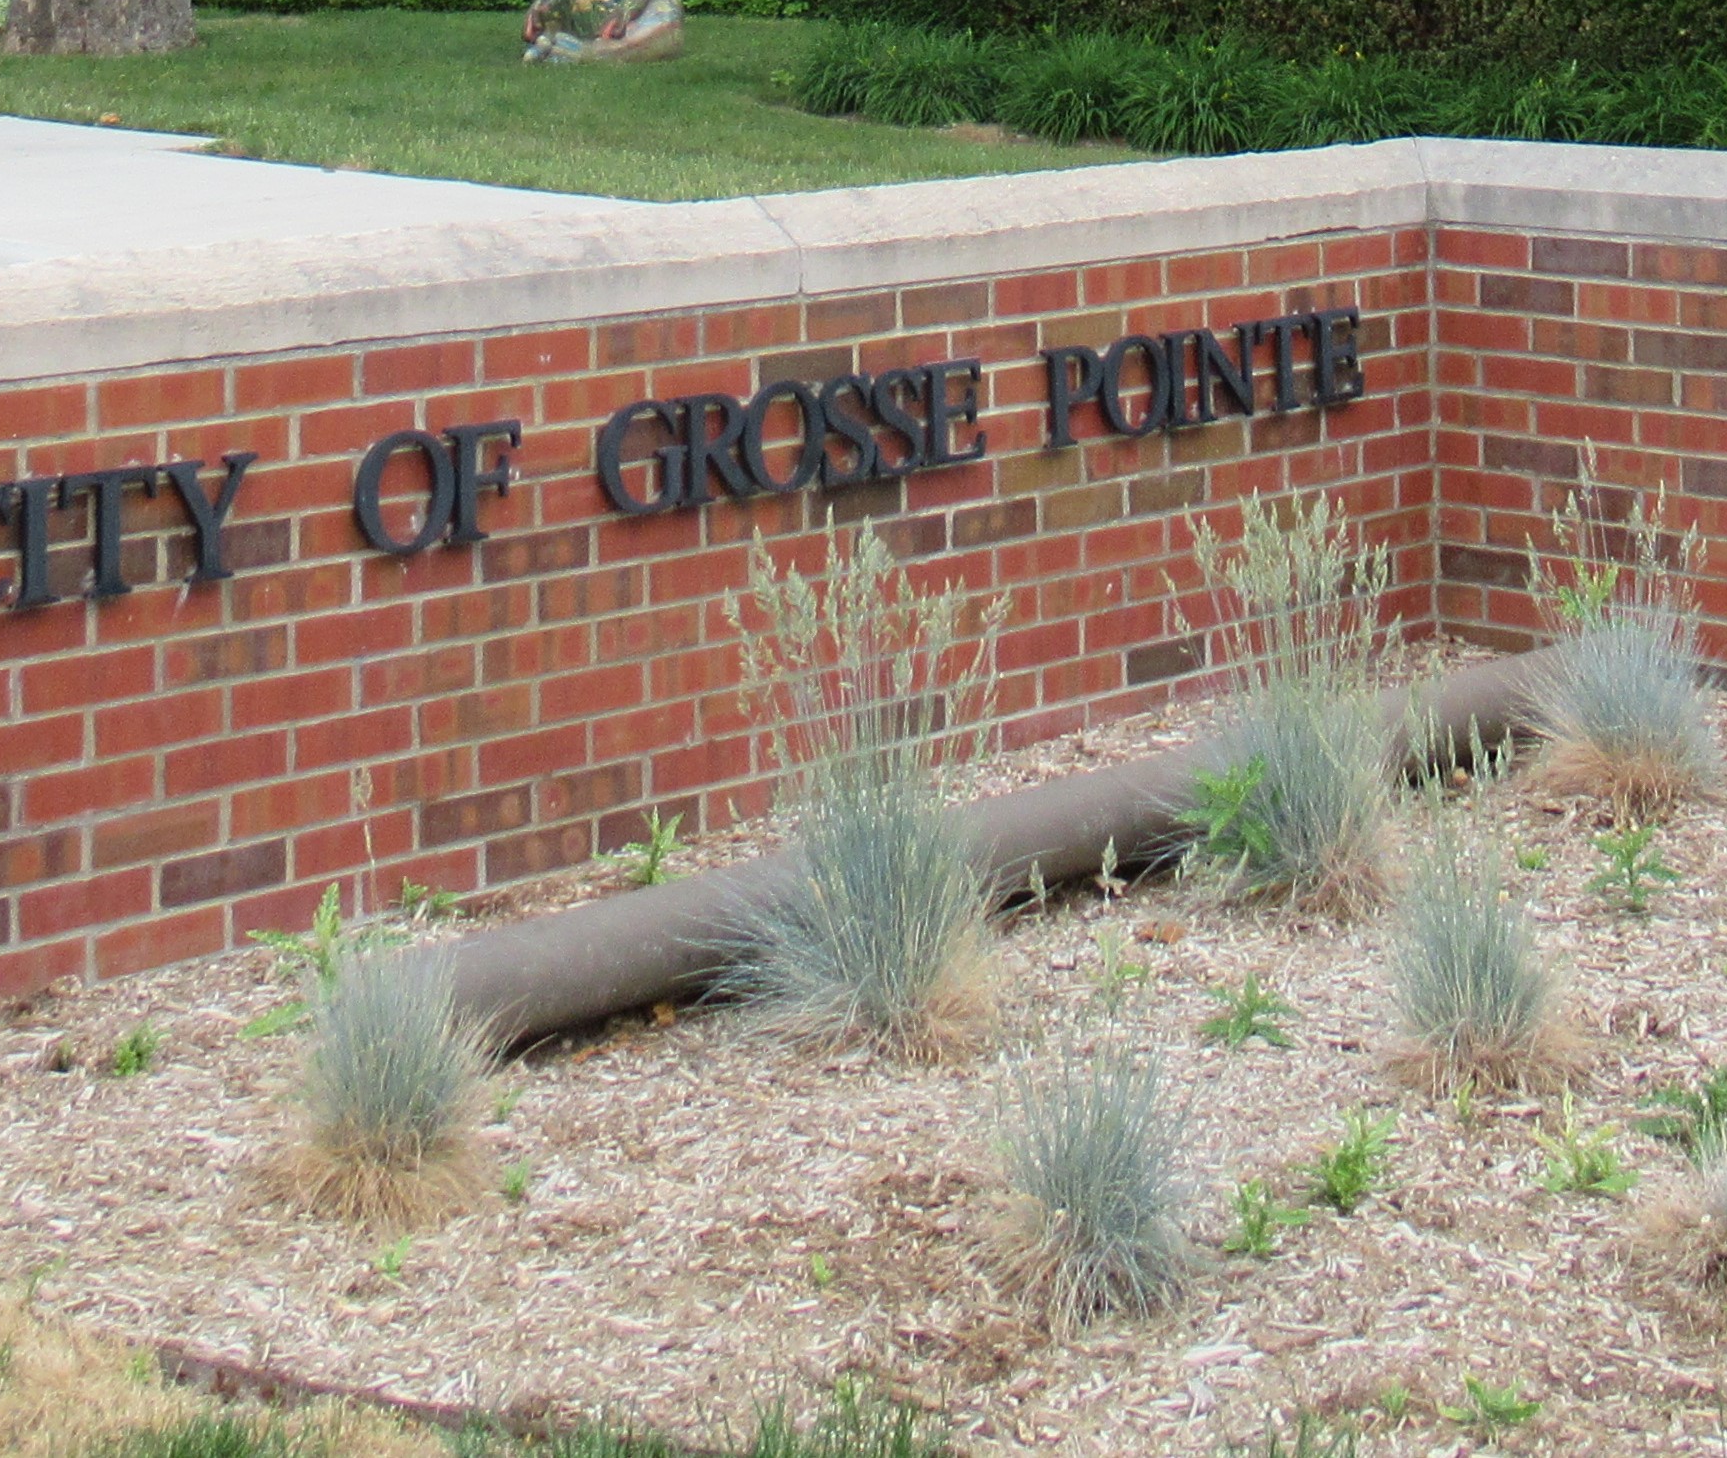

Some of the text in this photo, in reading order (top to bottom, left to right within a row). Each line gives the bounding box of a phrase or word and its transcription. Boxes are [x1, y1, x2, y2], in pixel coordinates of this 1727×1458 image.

[354, 421, 521, 555] OF
[596, 358, 985, 514] GROSSE
[1041, 306, 1364, 450] POINTE
